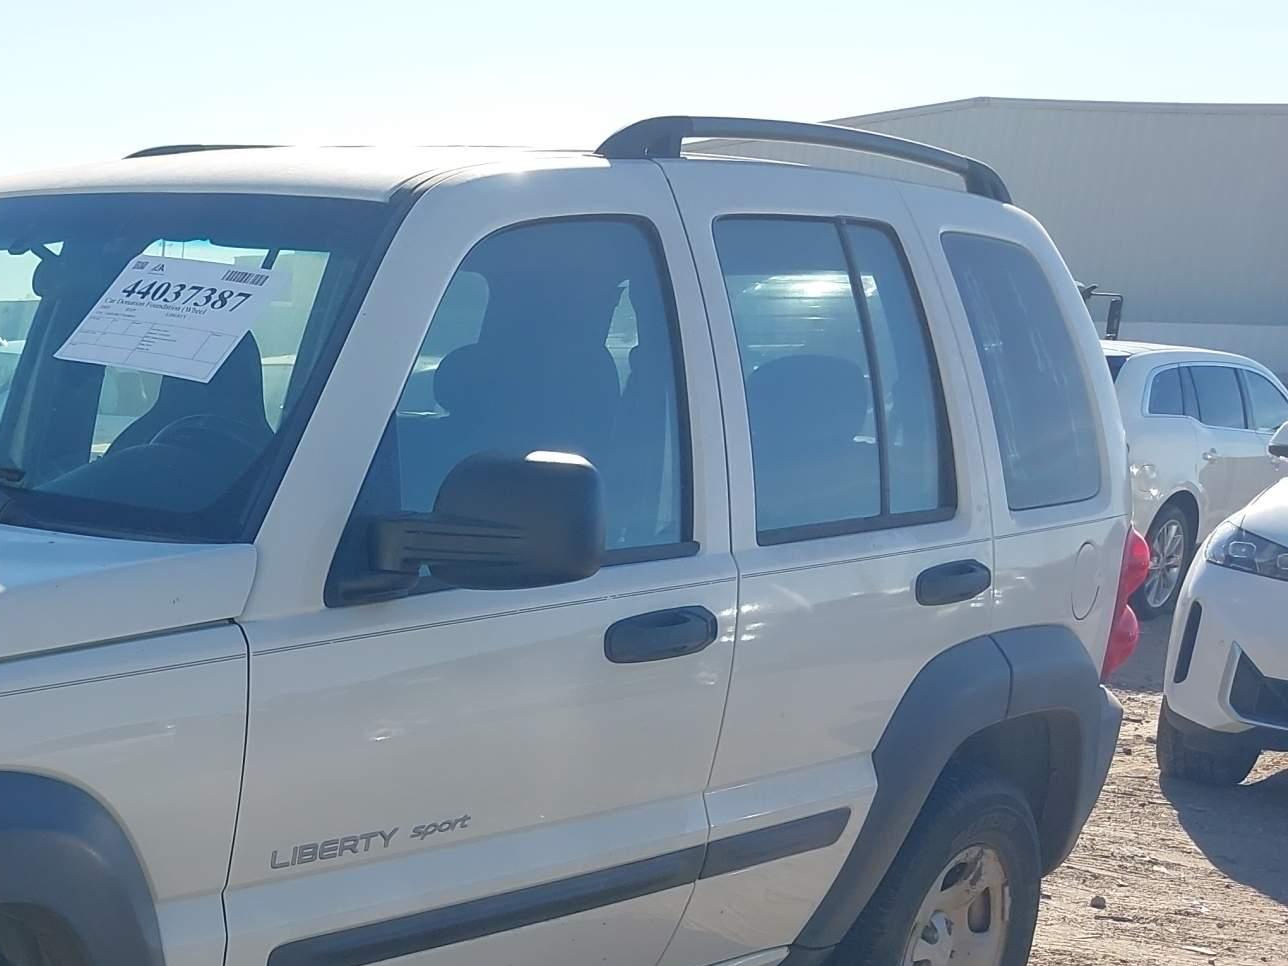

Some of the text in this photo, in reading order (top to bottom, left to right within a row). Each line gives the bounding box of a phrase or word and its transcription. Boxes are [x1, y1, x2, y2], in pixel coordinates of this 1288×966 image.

[122, 279, 253, 313] 44037387
[145, 301, 182, 312] Foundation
[270, 813, 472, 869] LIBERTY sport
